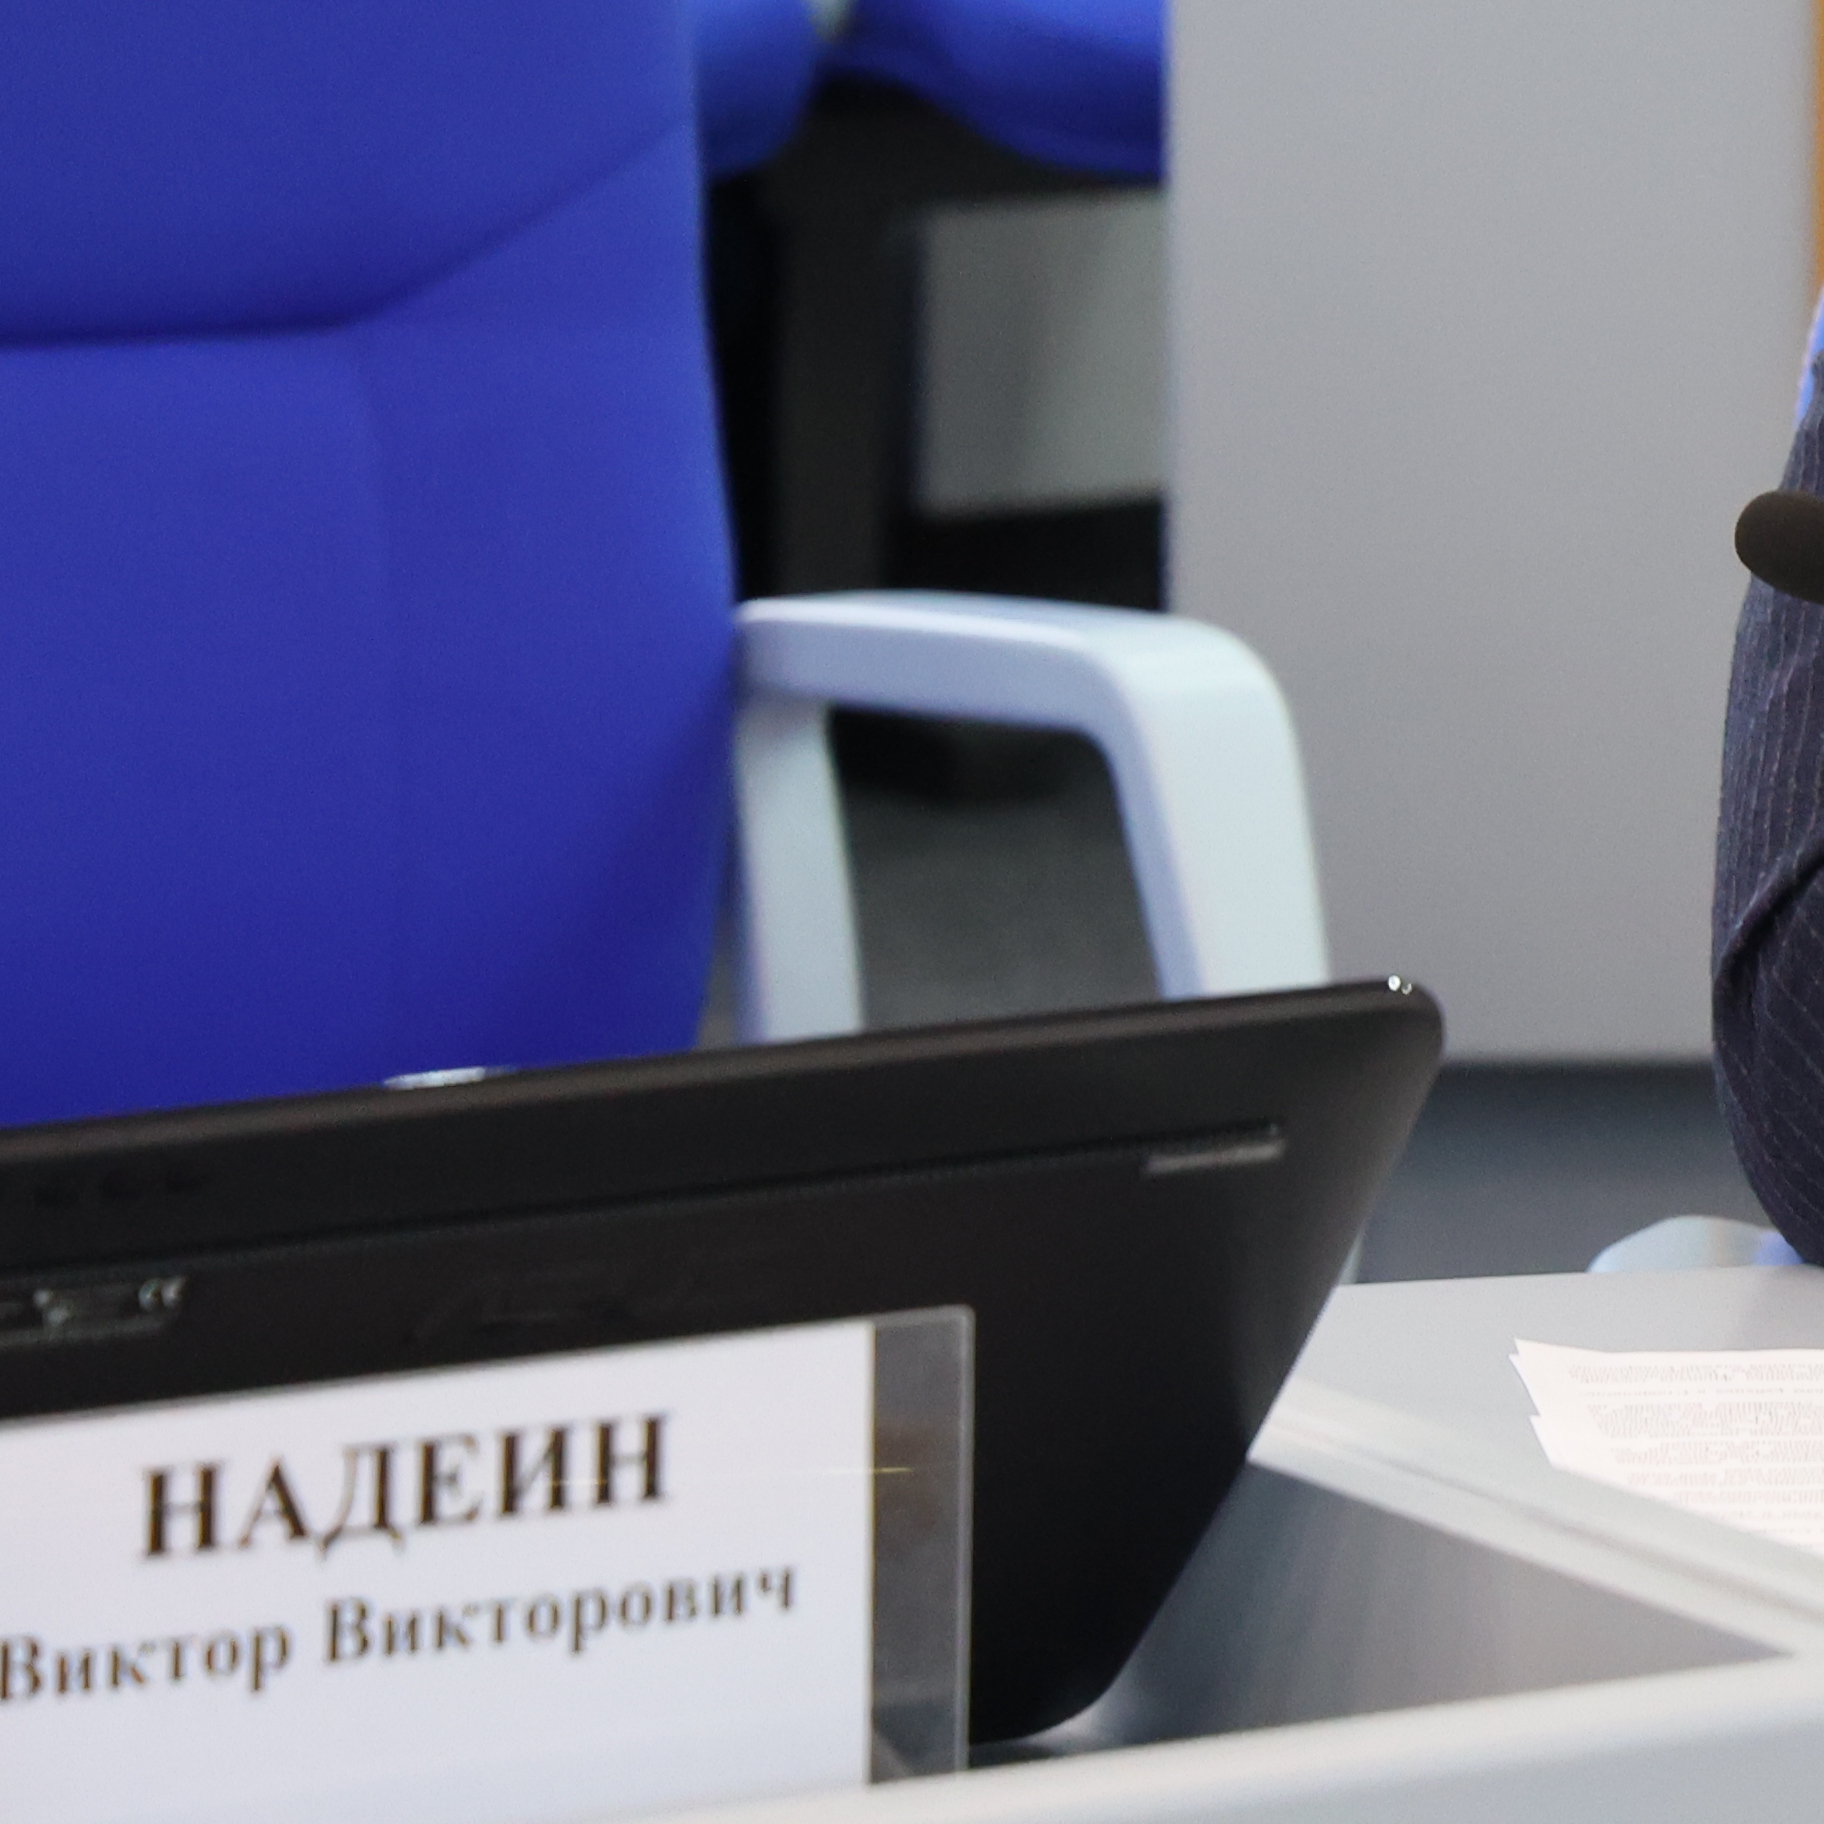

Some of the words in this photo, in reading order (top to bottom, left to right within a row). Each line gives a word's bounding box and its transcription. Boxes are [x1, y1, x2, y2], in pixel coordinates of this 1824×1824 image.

[140, 1412, 671, 1561] НАДЕИН
[0, 1625, 294, 1705] Виктор
[324, 1562, 798, 1664] Викторович
